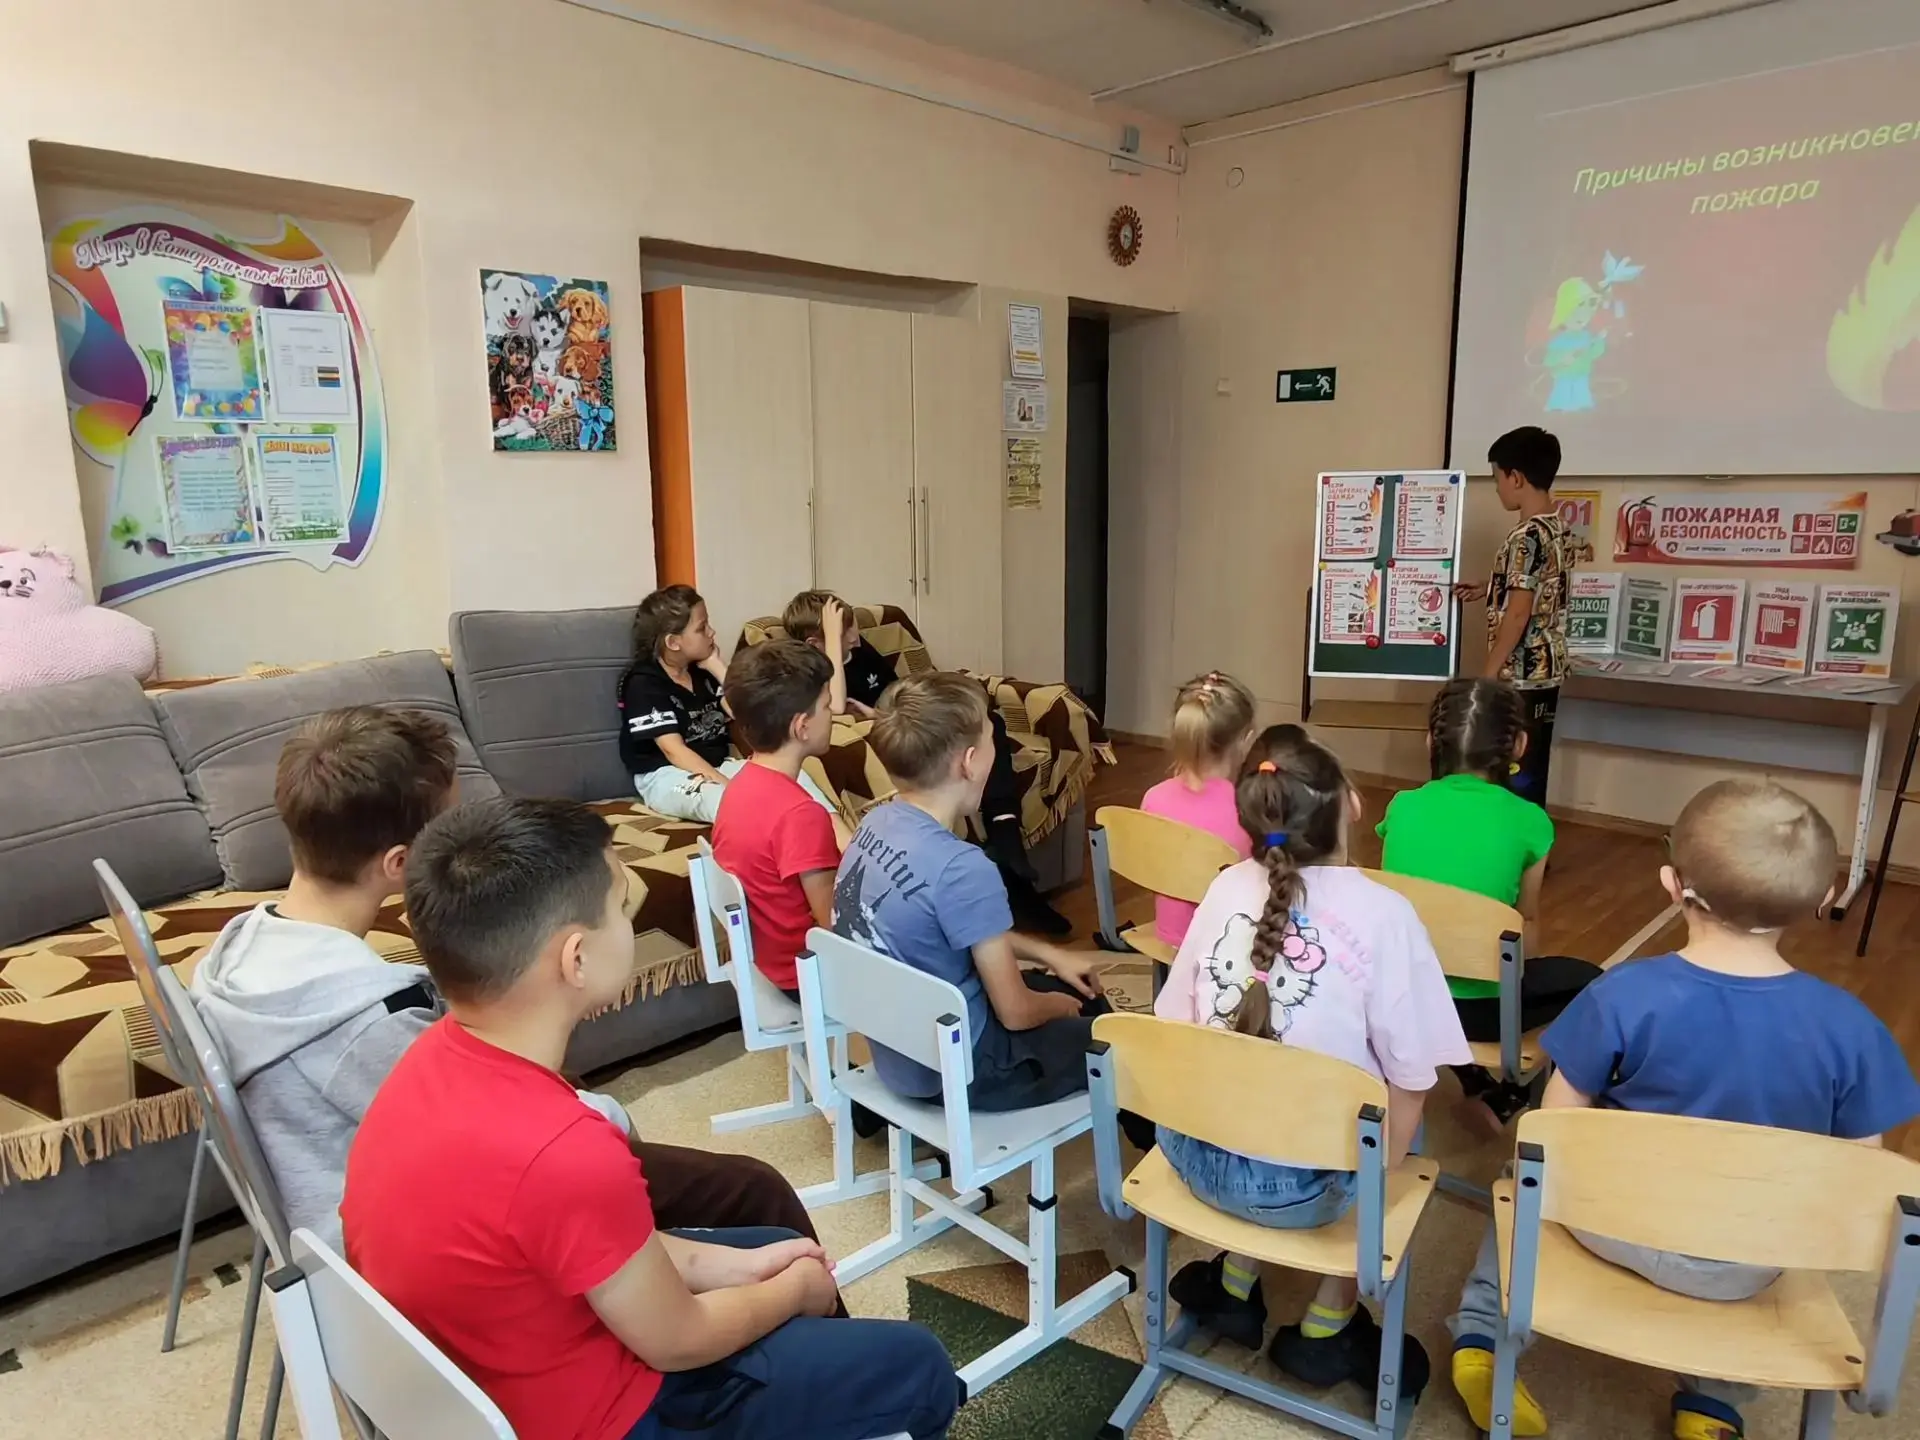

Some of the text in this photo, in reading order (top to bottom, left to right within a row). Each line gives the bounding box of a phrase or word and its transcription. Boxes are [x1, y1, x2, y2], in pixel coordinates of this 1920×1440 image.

[1573, 154, 1706, 196] Причины
[1690, 179, 1820, 215] пожара
[1557, 500, 1592, 526] 01
[1661, 507, 1780, 524] ПОЖАРНАЯ
[1660, 525, 1787, 540] БЕЗОПАСНОСТЬ
[850, 825, 931, 902] owerful
